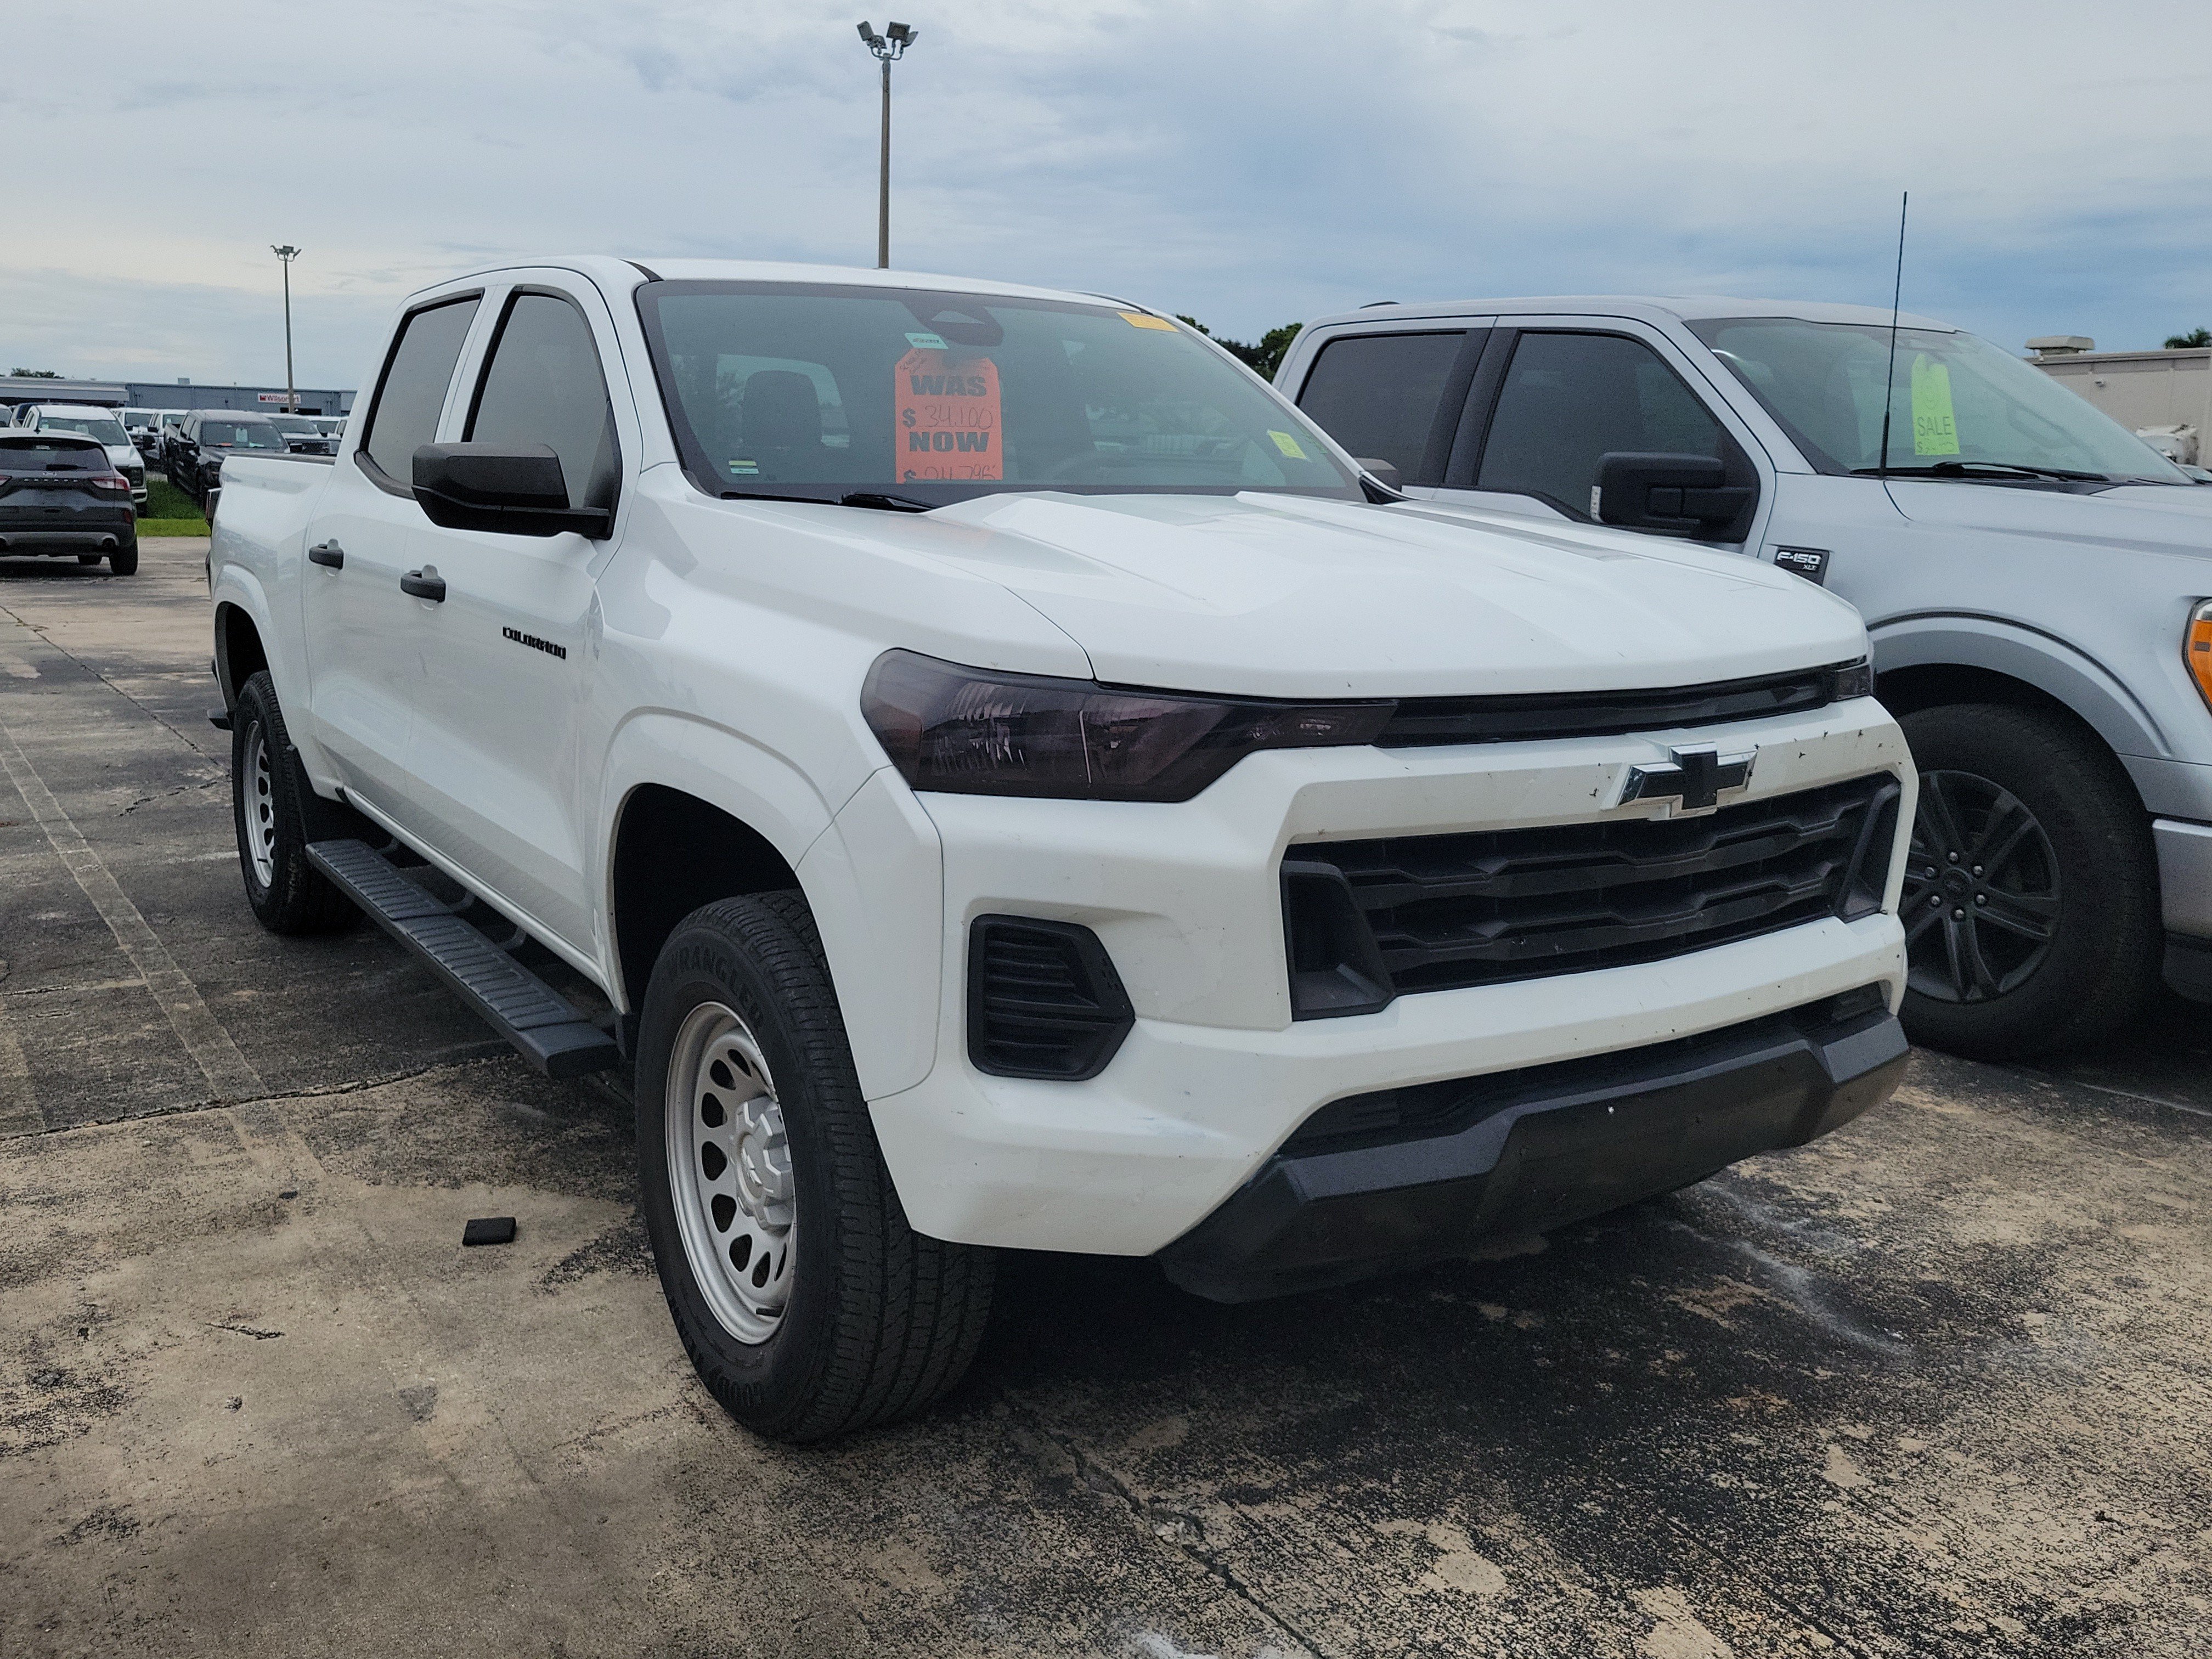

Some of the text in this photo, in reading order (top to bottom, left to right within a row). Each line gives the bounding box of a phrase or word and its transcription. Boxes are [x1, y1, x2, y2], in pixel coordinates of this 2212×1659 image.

[910, 375, 986, 397] WAS
[902, 408, 916, 428] $
[1917, 416, 1952, 436] SALE
[910, 432, 989, 452] NOW
[1776, 551, 1821, 565] F-150
[502, 626, 566, 660] COLORADO
[667, 945, 763, 1032] WRANGLER
